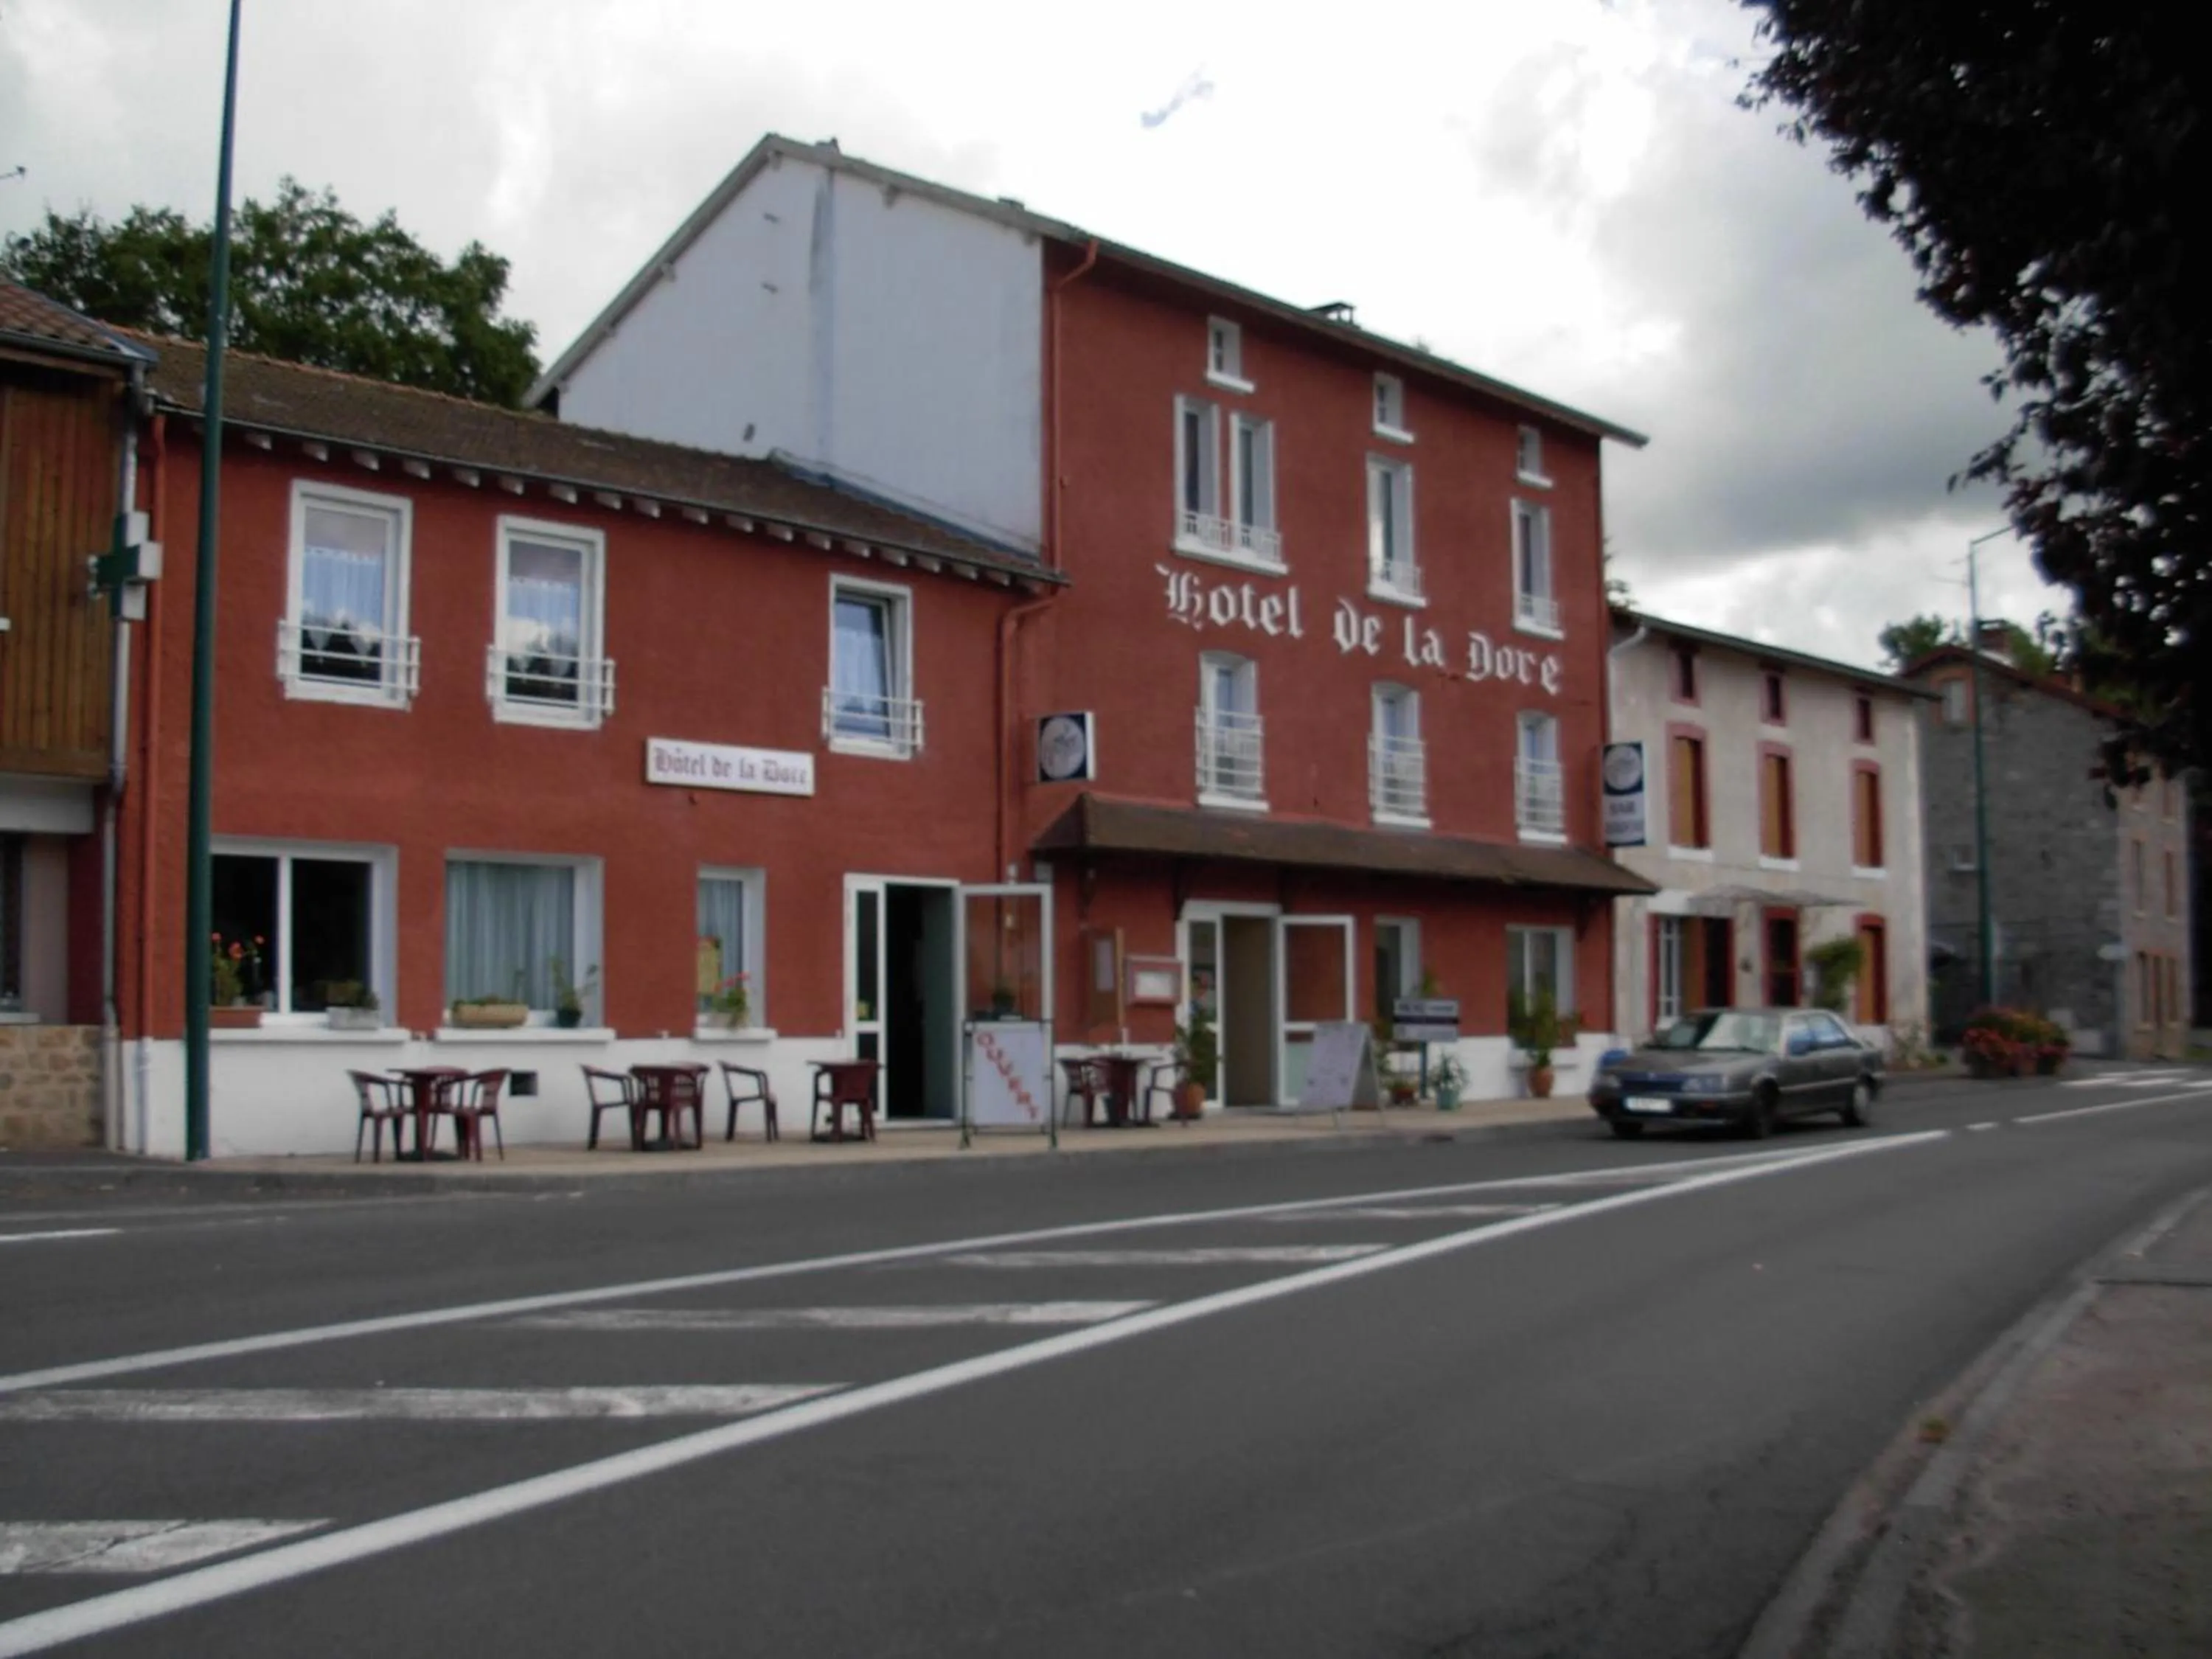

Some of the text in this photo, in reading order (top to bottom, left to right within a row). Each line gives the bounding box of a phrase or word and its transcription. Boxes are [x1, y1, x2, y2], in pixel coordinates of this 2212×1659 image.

[1155, 563, 1561, 696] Hotel de la Dore
[711, 755, 732, 778] de
[739, 757, 755, 779] la
